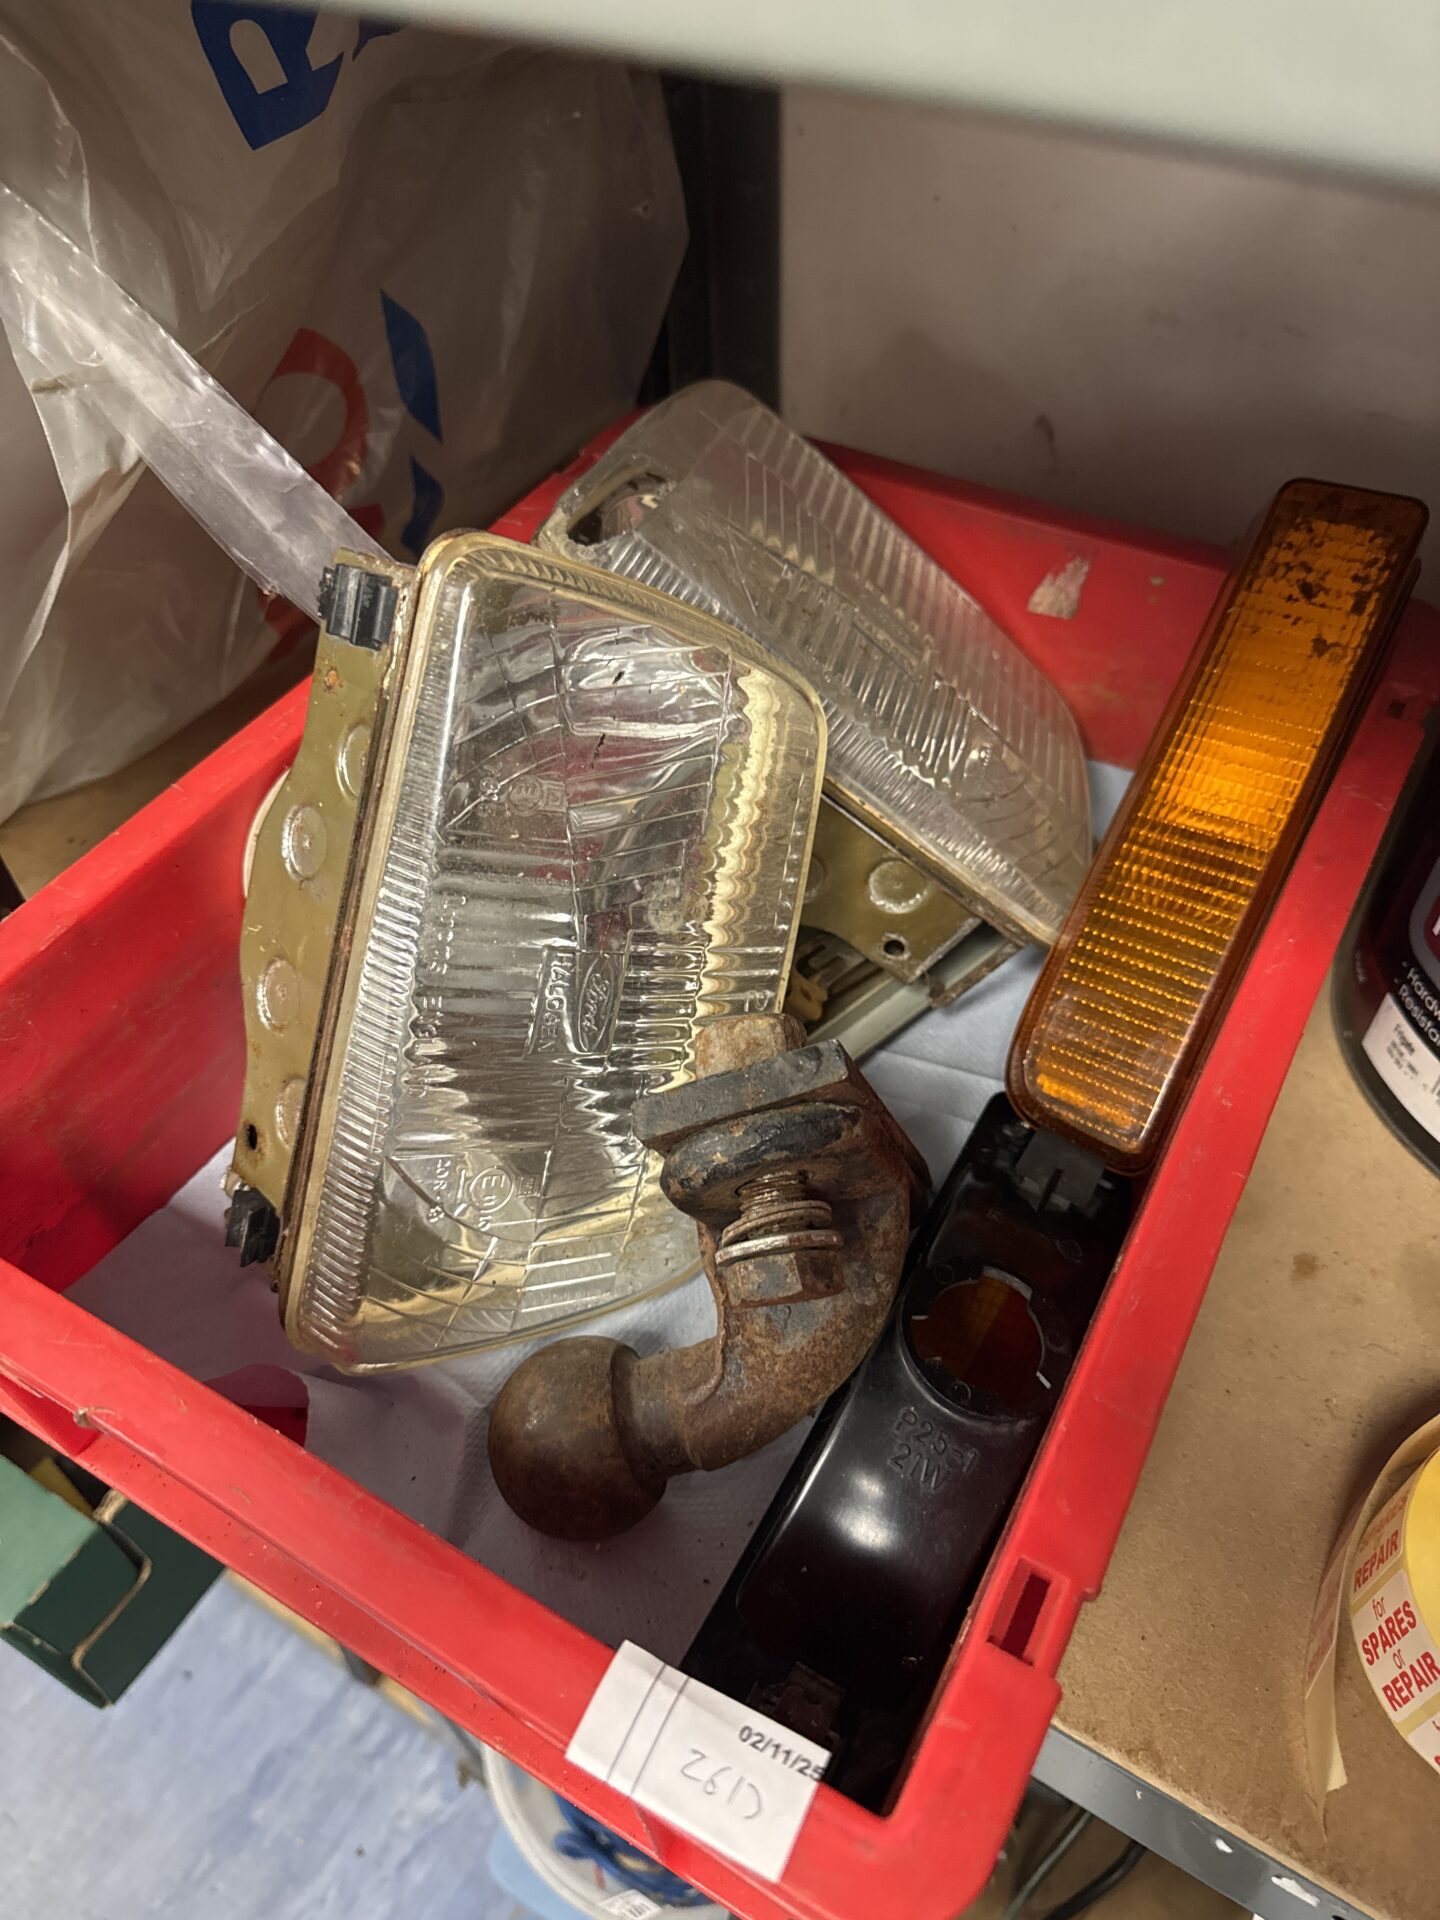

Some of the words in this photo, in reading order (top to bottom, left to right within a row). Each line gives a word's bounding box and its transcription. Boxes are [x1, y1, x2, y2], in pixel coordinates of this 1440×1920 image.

[581, 972, 611, 1036] Ford
[888, 1442, 952, 1492] 21W
[1353, 1529, 1399, 1594] REPAIR
[1362, 1600, 1417, 1666] SPARES
[1372, 1597, 1386, 1621] for
[1382, 1651, 1440, 1712] REPAIR
[1392, 1648, 1406, 1670] or
[738, 1724, 827, 1782] 02/11/25
